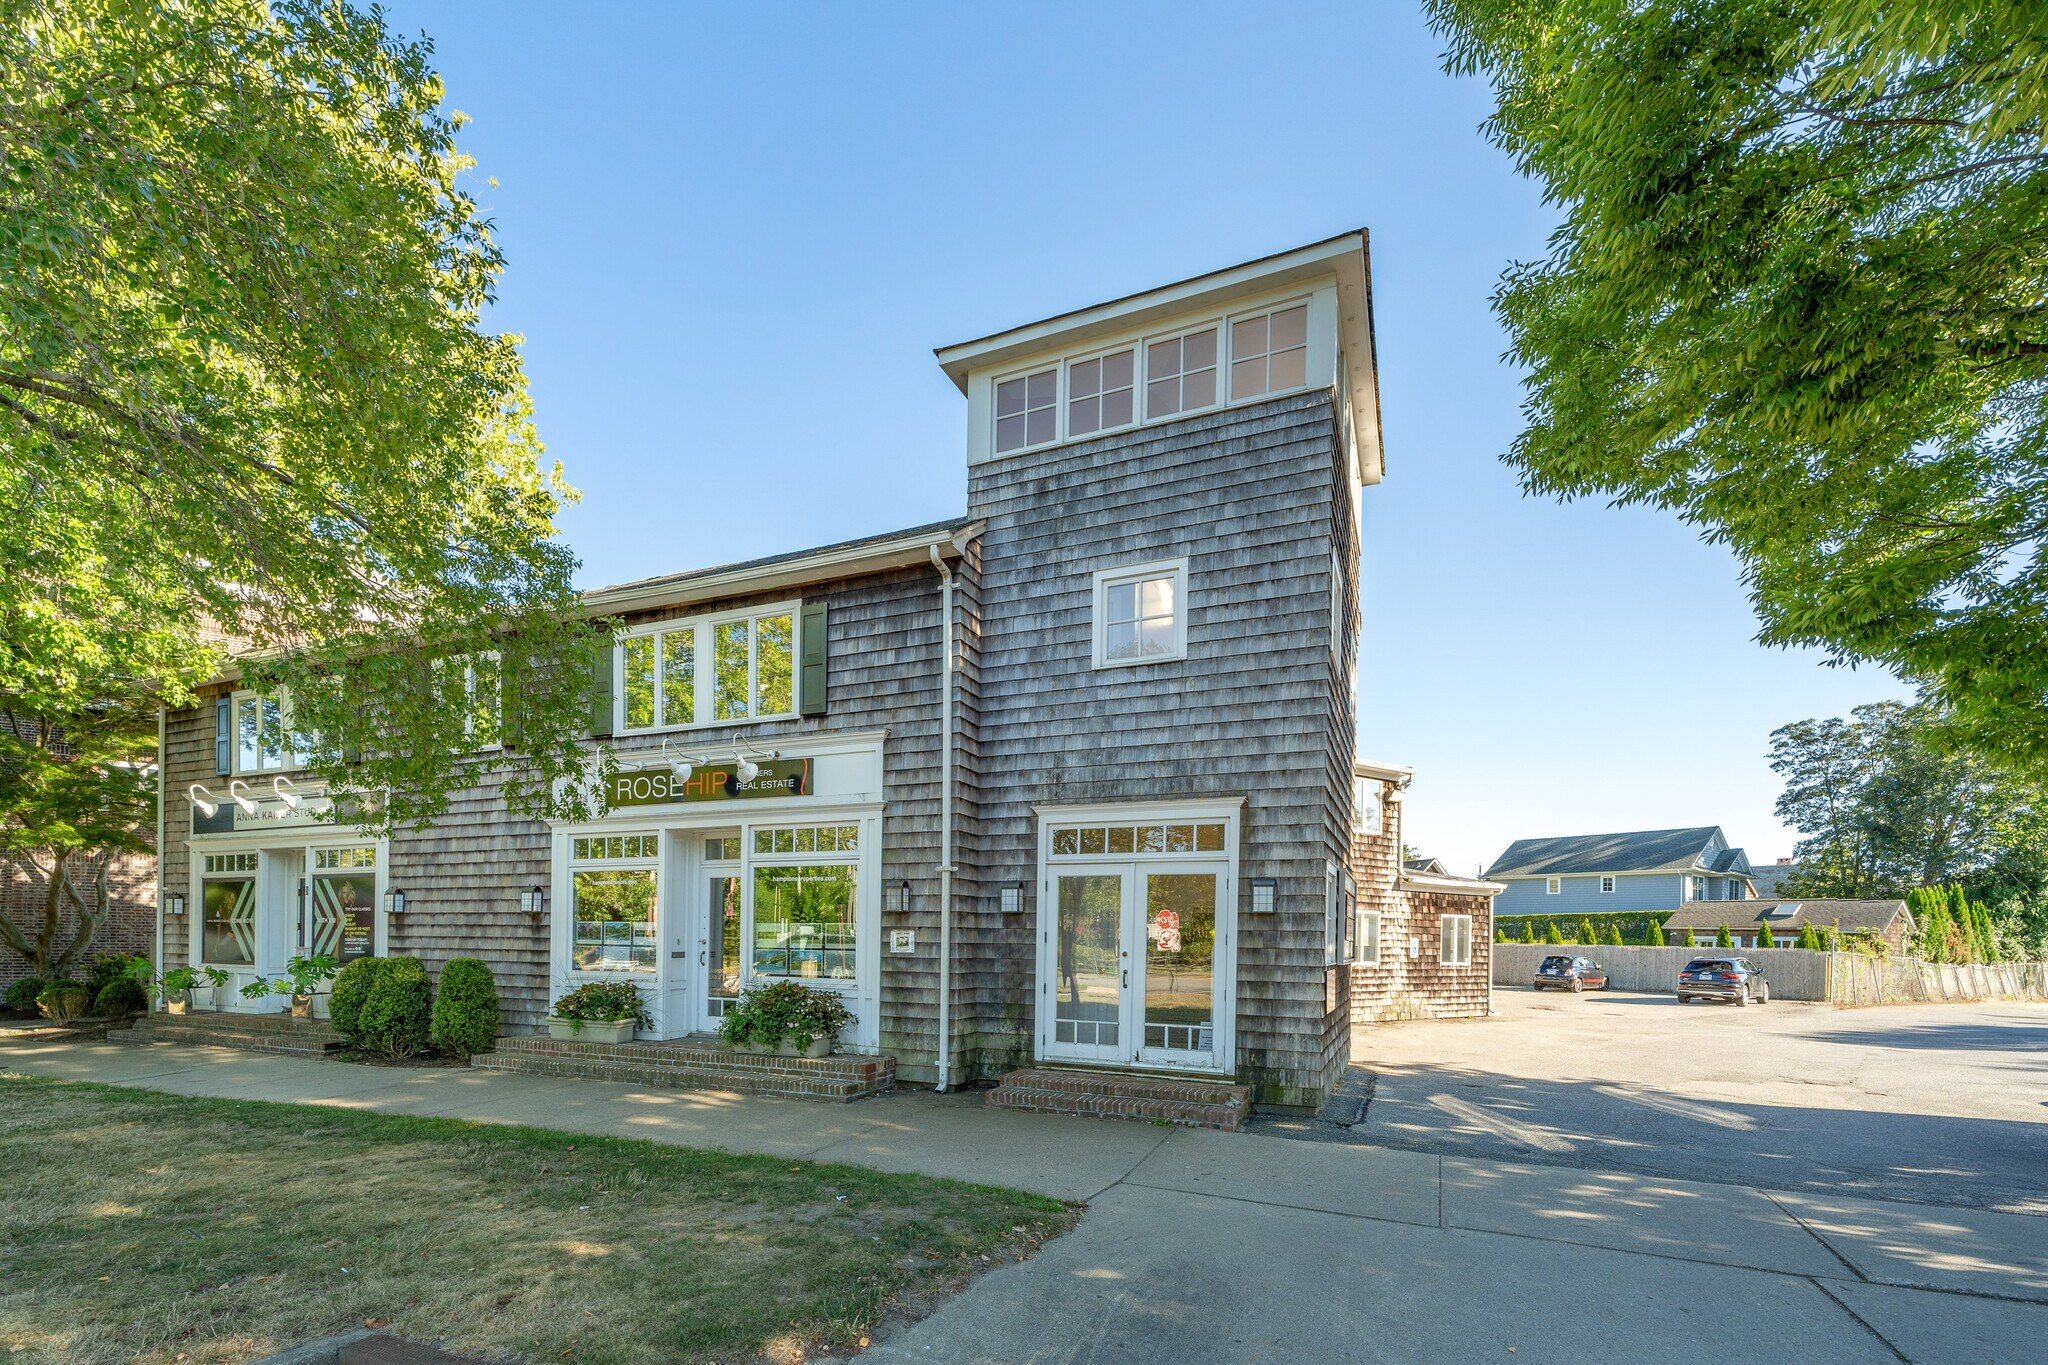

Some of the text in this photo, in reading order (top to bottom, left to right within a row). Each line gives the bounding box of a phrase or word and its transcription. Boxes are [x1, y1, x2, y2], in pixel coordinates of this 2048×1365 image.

[736, 778, 795, 791] REAL ESTATE
[236, 811, 259, 822] ANNA
[262, 809, 291, 820] KAIR
[772, 874, 837, 883] hamptonsroperties.com
